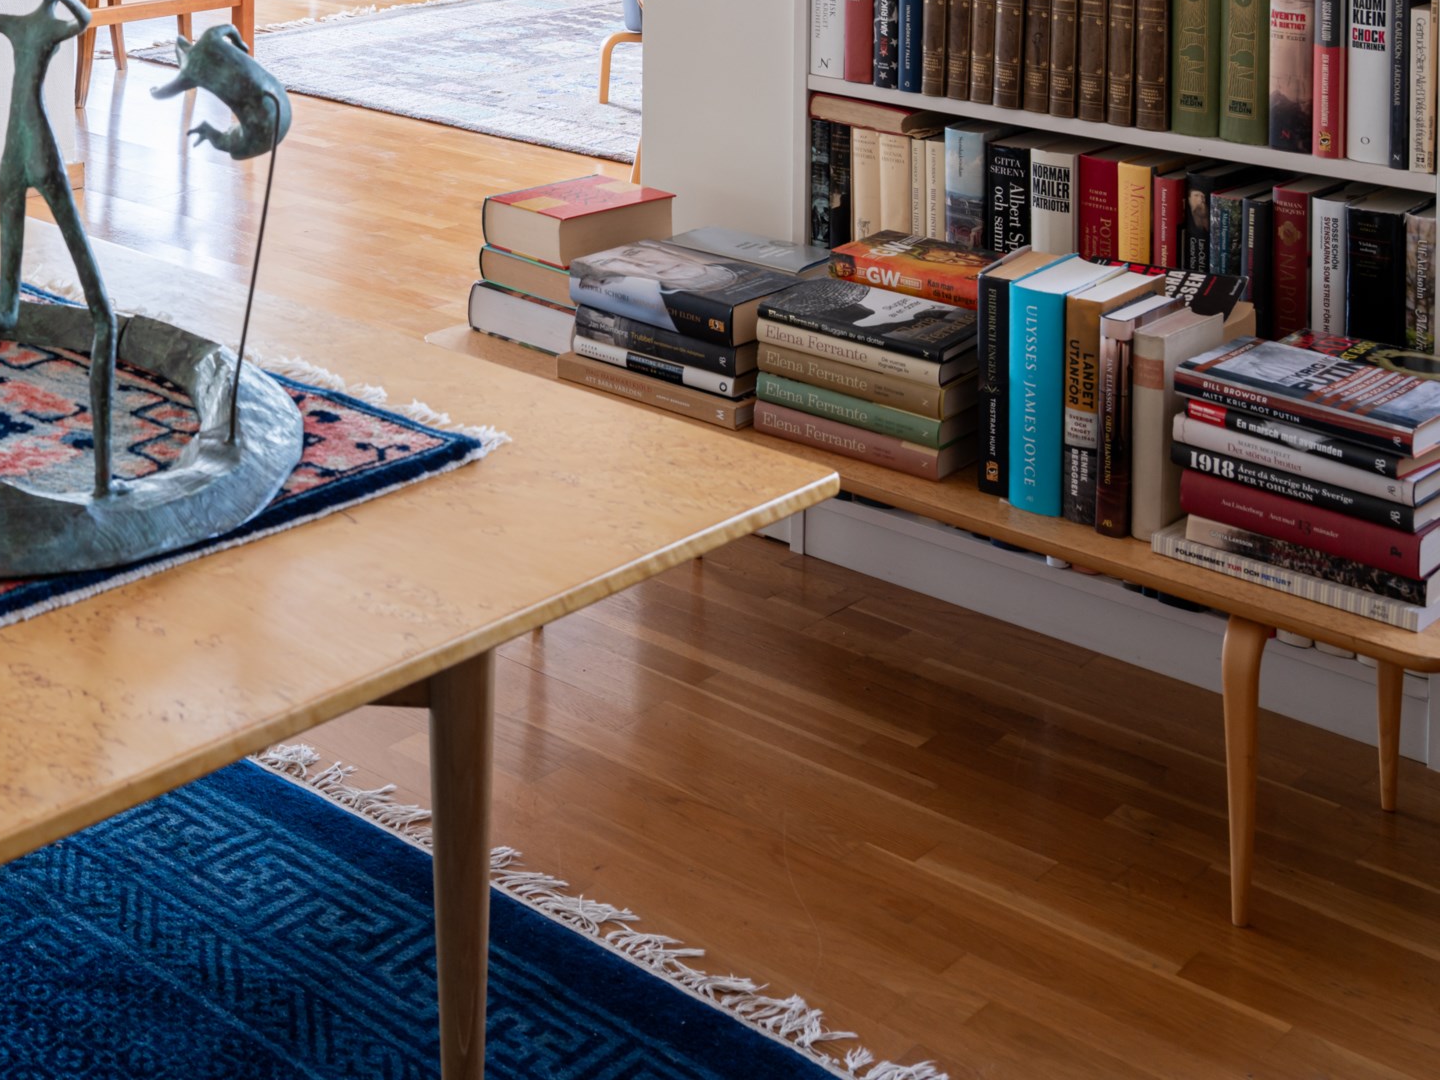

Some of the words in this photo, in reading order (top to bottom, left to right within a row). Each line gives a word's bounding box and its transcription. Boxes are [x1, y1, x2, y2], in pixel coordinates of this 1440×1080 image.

[1352, 9, 1386, 27] KLEIN
[1352, 27, 1385, 44] CHOCK
[1352, 41, 1386, 52] DOKTRINEN
[1394, 22, 1403, 60] CARLSSON
[990, 164, 1026, 178] SERENY
[994, 156, 1021, 168] GITTA
[1032, 163, 1070, 183] NORMAN
[994, 186, 1009, 211] och
[1032, 177, 1070, 199] MAILER
[1009, 181, 1025, 229] Albert
[1032, 196, 1070, 214] PATRIOTEN
[1417, 239, 1427, 257] Ulf
[865, 266, 901, 288] GW
[927, 279, 941, 288] Kan
[941, 282, 954, 291] man
[1416, 258, 1427, 299] Adelsohn
[988, 288, 997, 341] FRIEDRICH
[631, 331, 654, 344] Trubbel
[764, 324, 804, 345] Elena
[807, 336, 867, 363] Ferrante
[821, 323, 850, 338] Skuggan
[866, 334, 886, 345] dotter
[1025, 305, 1038, 371] ULYSSES
[765, 350, 804, 372] Elena
[807, 361, 868, 391] Ferrante
[987, 343, 997, 387] ENGELS
[1068, 339, 1080, 405] UTANFÖR
[1082, 353, 1094, 408] LANDET
[765, 381, 804, 404] Elena
[808, 394, 868, 422] Ferrante
[1023, 381, 1036, 432] JAMES
[1105, 372, 1113, 413] ELIASSON
[1202, 392, 1223, 403] MITT
[1226, 396, 1247, 408] KRIG
[1250, 402, 1269, 413] MOT
[1273, 407, 1300, 423] PUTIN
[1203, 381, 1221, 392] BILL
[1223, 385, 1268, 404] BROWDER
[762, 412, 802, 434] Elena
[806, 423, 866, 452] Ferrante
[1236, 418, 1247, 428] En
[1249, 421, 1278, 439] marsch
[1281, 428, 1297, 441] mot
[1298, 434, 1343, 458] avgrunden
[1023, 437, 1036, 487] JOYCE
[1071, 448, 1079, 496] BERGGREN
[1080, 450, 1088, 482] HENRIK
[1189, 450, 1234, 480] 1918
[1237, 463, 1256, 477] Året
[1269, 471, 1301, 489] Sverige
[1302, 479, 1320, 494] blev
[1321, 486, 1354, 505] Sverige
[1237, 474, 1256, 485] PER
[1266, 482, 1313, 502] OHLSSON
[1175, 547, 1226, 567] FOLKHEMMET
[1243, 567, 1260, 578] OCH
